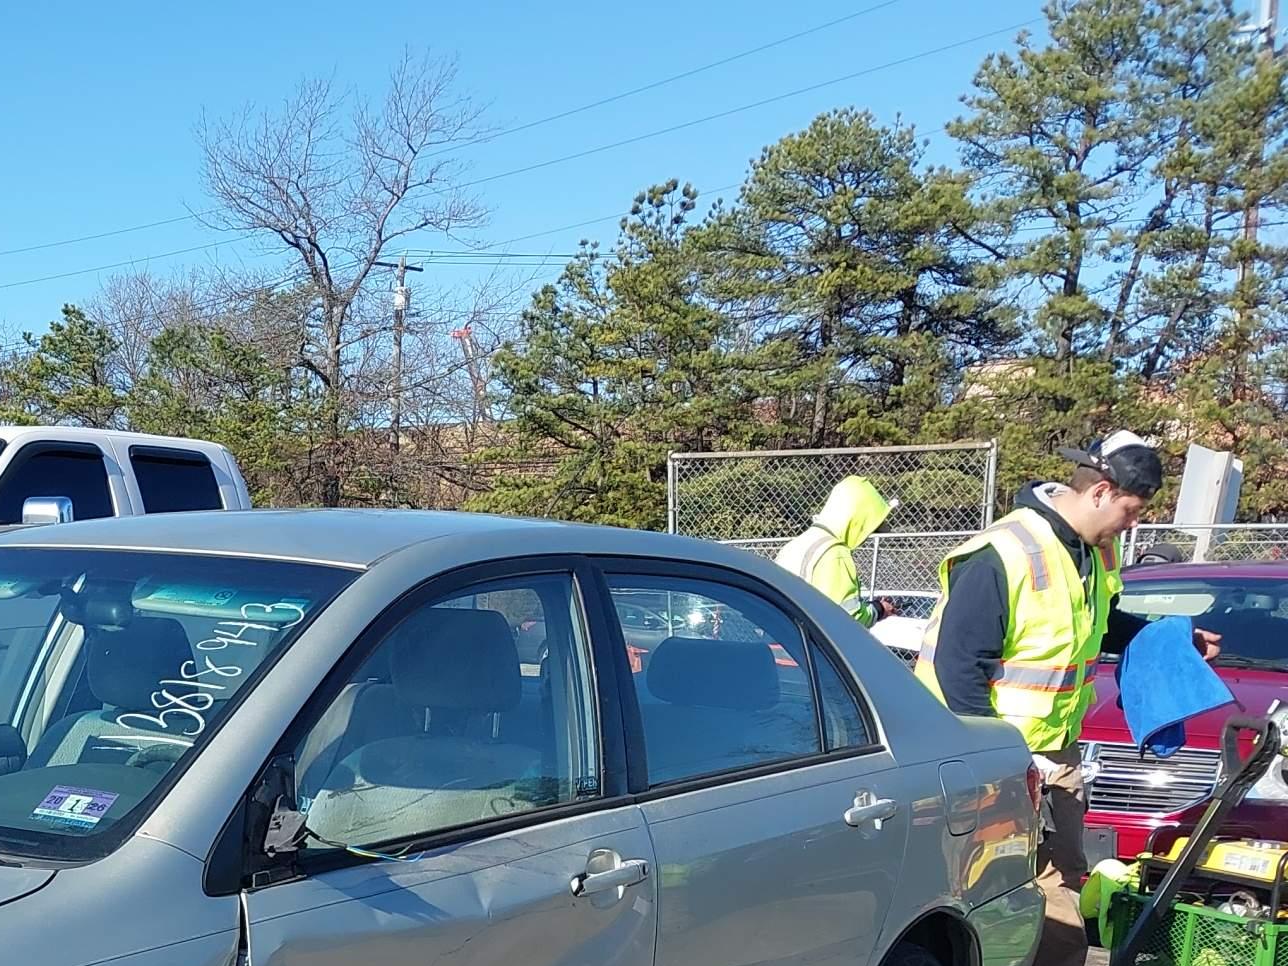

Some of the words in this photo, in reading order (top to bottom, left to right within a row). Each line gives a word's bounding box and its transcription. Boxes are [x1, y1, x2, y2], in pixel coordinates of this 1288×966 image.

[46, 795, 63, 805] 20
[67, 799, 82, 813] 1
[87, 802, 107, 812] 26
